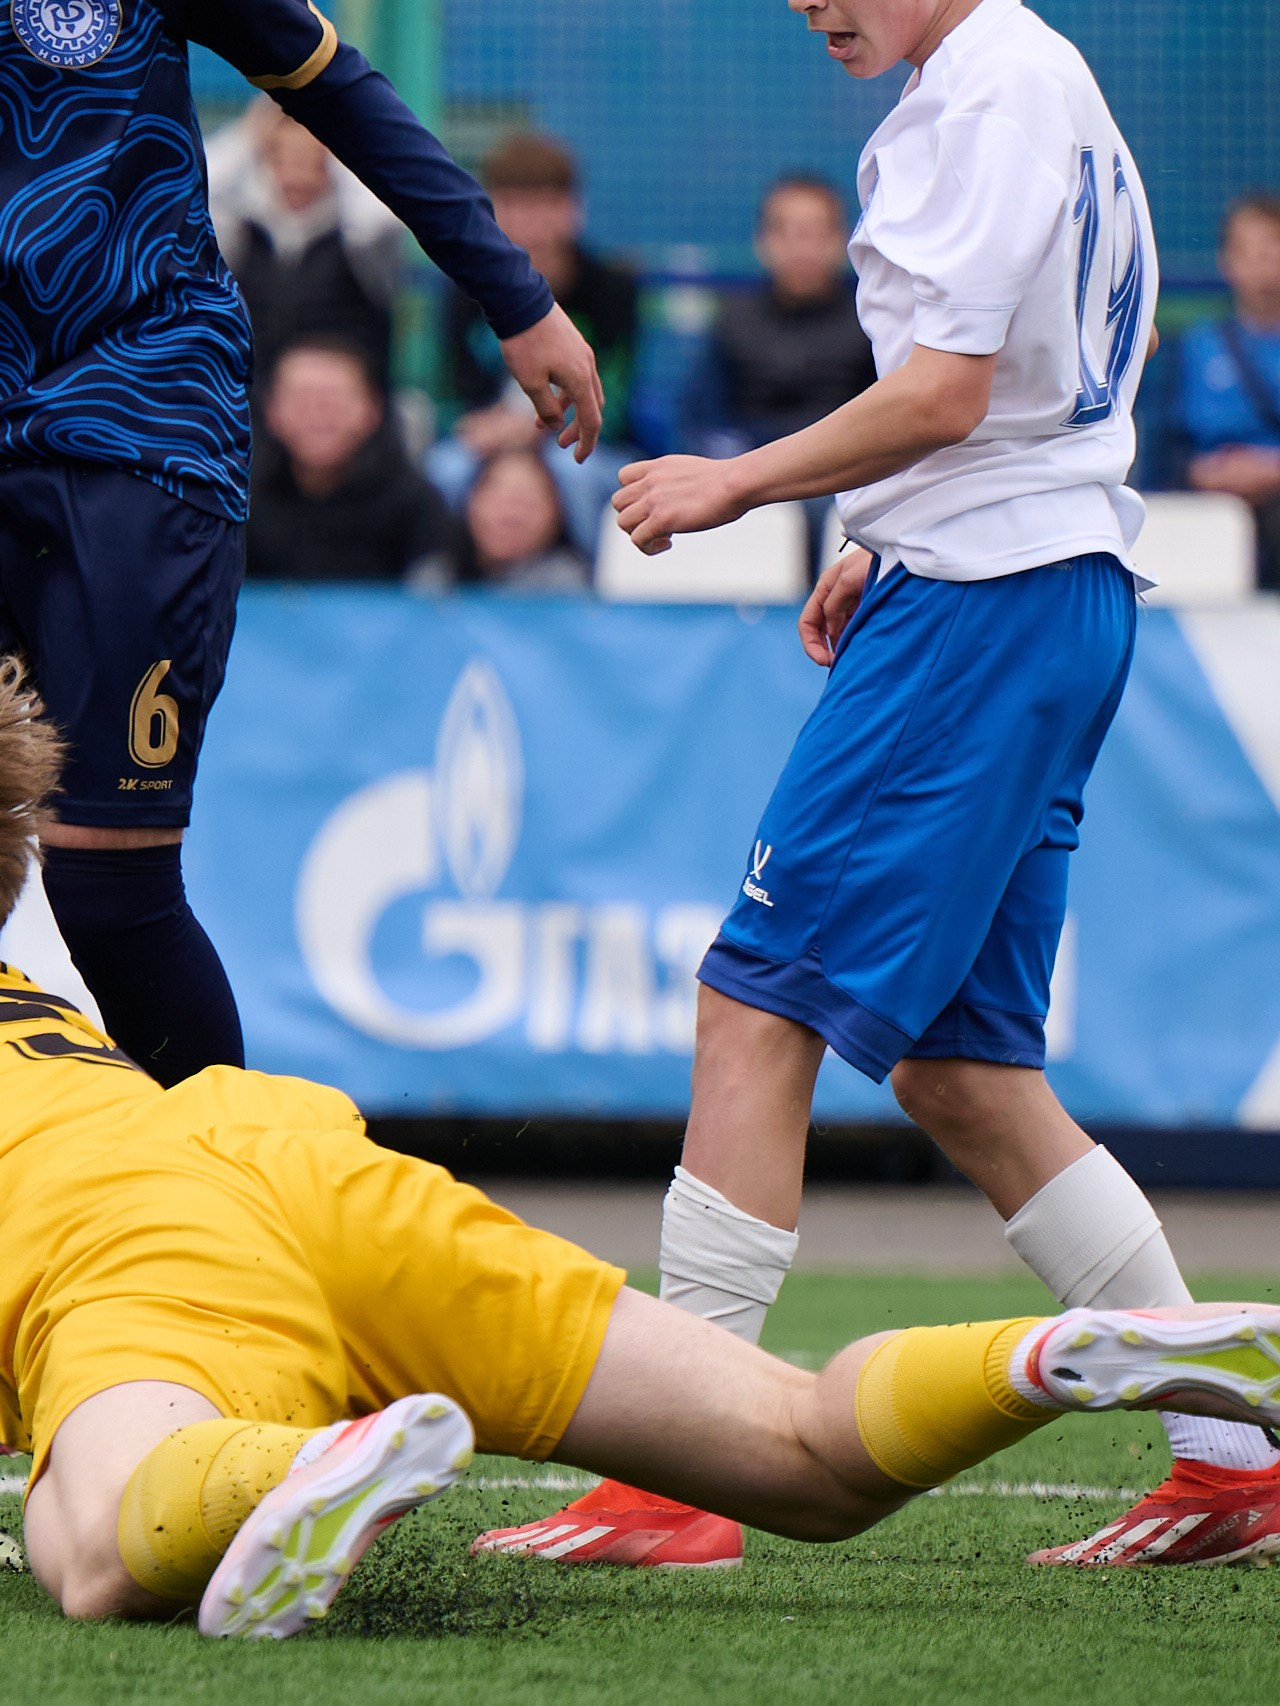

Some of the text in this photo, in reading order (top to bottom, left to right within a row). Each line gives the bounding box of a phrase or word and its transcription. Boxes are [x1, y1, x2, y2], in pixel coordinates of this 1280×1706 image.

[14, 0, 34, 46] ТРУД
[1060, 145, 1145, 429] 19
[128, 659, 180, 769] 6
[139, 779, 174, 791] SPORT
